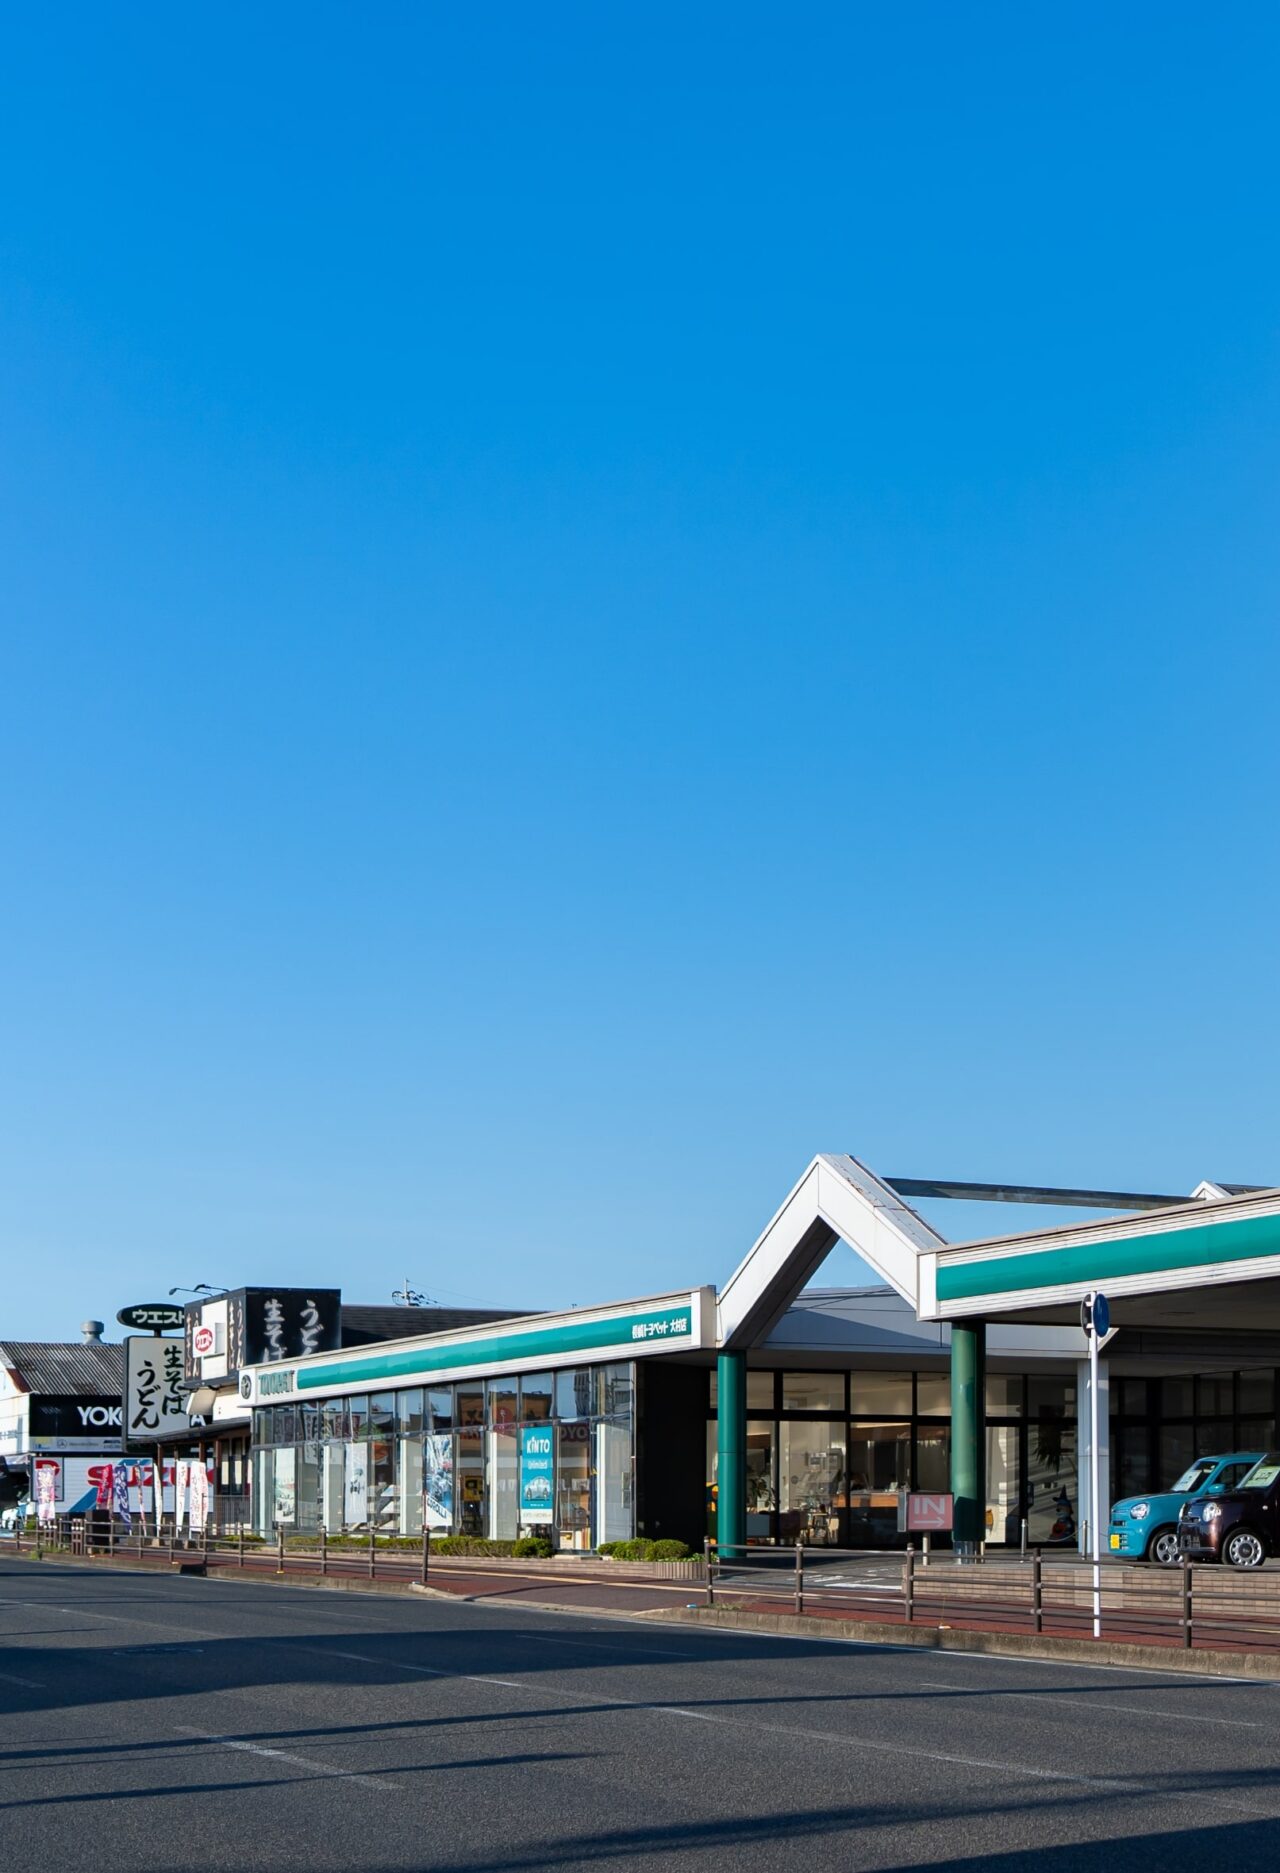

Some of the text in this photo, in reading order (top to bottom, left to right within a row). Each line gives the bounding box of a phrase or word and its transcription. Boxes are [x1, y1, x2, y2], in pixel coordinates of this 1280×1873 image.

[131, 1360, 161, 1430] うどん
[162, 1345, 187, 1416] 生そば
[913, 1497, 945, 1516] IN
